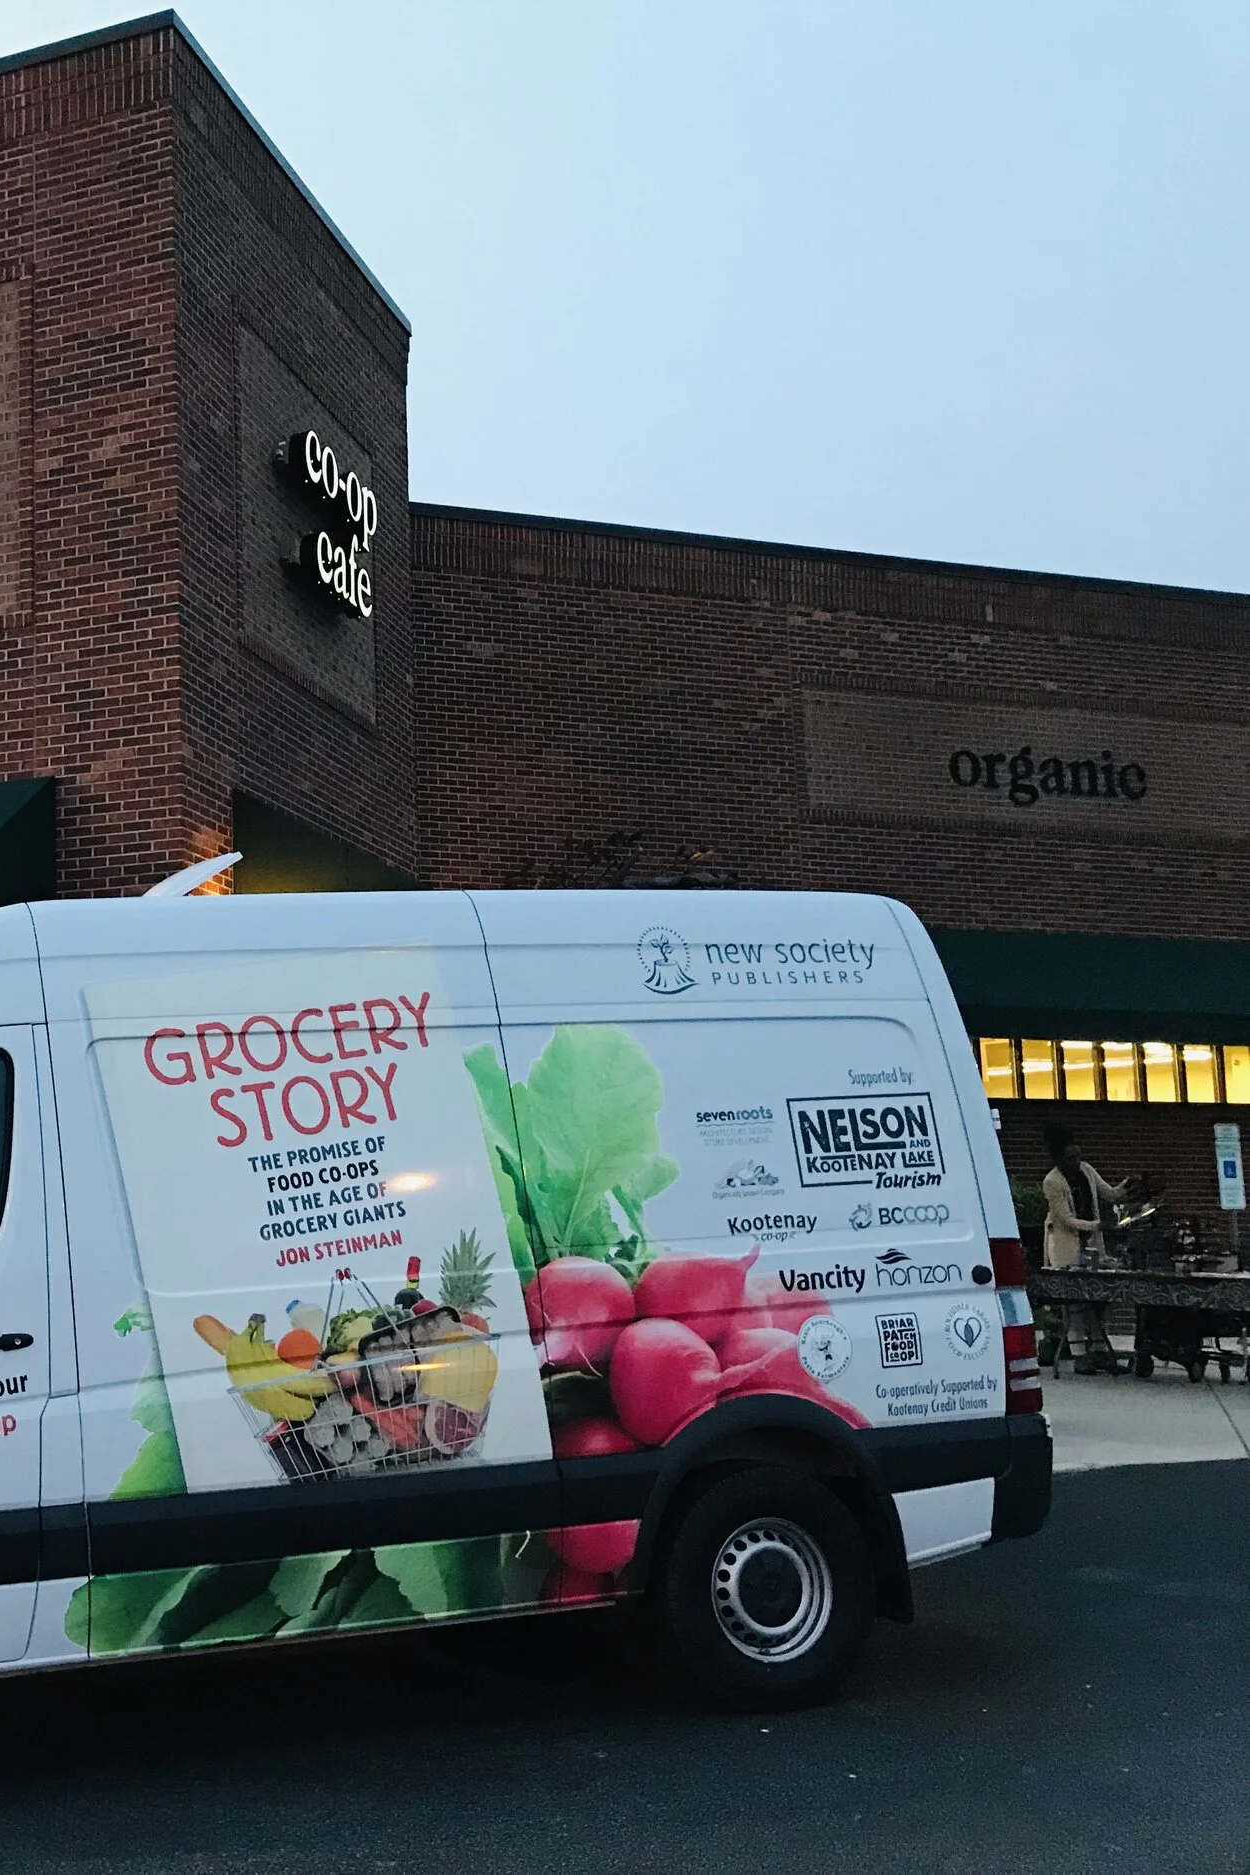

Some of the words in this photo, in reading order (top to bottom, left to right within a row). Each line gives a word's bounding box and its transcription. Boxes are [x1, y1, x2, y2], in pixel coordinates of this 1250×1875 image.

[305, 429, 378, 552] co-op
[317, 531, 373, 618] cafe
[949, 745, 1148, 807] organic
[704, 942, 763, 964] new
[775, 938, 875, 970] society
[711, 970, 864, 985] PUBLISHERS
[144, 992, 431, 1086] GROCERY
[848, 1066, 898, 1087] Supported
[210, 1062, 398, 1148] STORY
[797, 1105, 929, 1154] NELSON
[909, 1138, 931, 1149] AND
[248, 1153, 284, 1173] THE
[287, 1140, 362, 1167] PROMISE
[365, 1136, 386, 1154] OF
[901, 1150, 935, 1168] LAKE
[267, 1171, 315, 1193] FOOD
[318, 1160, 380, 1184] CO-OPS
[875, 1171, 942, 1189] Tourism
[267, 1200, 285, 1217] IN
[291, 1193, 324, 1212] THE
[329, 1185, 364, 1205] AGE
[367, 1180, 388, 1199] OF
[259, 1212, 338, 1241] GROCERY
[343, 1200, 407, 1227] GIANTS
[727, 1213, 817, 1236] Kootenay
[276, 1246, 311, 1267] JON
[315, 1229, 403, 1261] STEINMAN
[760, 1231, 789, 1243] co-op
[779, 1264, 866, 1294] Vancity
[875, 1263, 963, 1287] horizon
[881, 1318, 914, 1330] BRIAR
[883, 1328, 917, 1342] PATCH
[884, 1340, 914, 1362] FOOD
[876, 1379, 939, 1400] Co-operatively
[941, 1374, 985, 1395] Supported
[987, 1374, 998, 1392] by
[887, 1401, 929, 1417] Kootenay
[931, 1396, 957, 1413] Credit
[959, 1395, 989, 1411] Unions
